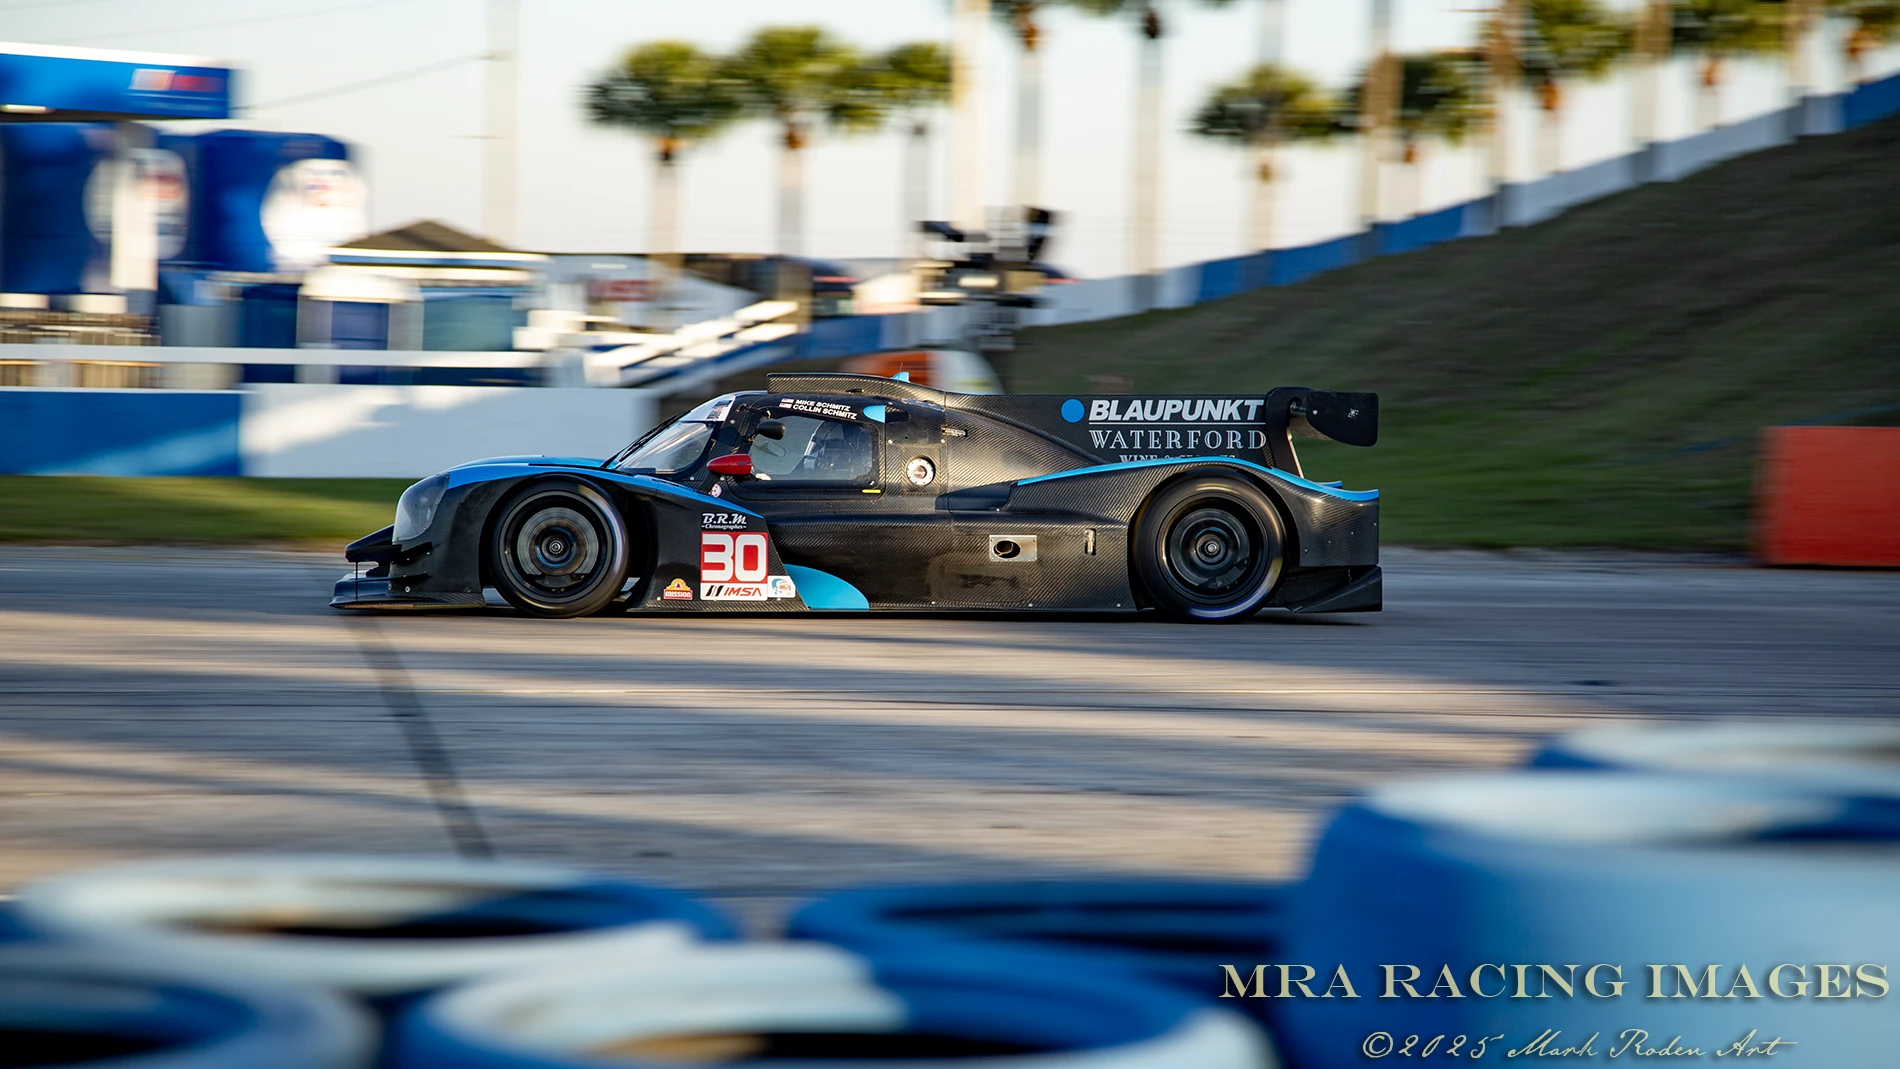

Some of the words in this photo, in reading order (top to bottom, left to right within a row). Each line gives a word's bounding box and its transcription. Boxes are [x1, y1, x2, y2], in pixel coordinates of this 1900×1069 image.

[792, 403, 821, 414] COLLIN
[822, 407, 858, 420] SCHMITZ
[795, 399, 815, 407] MIKE
[816, 402, 851, 411] SCHMITZ
[1088, 399, 1264, 421] BLAUPUNKT
[1088, 429, 1267, 449] WATERFORD
[702, 533, 767, 582] 30
[723, 587, 762, 597] IMSA
